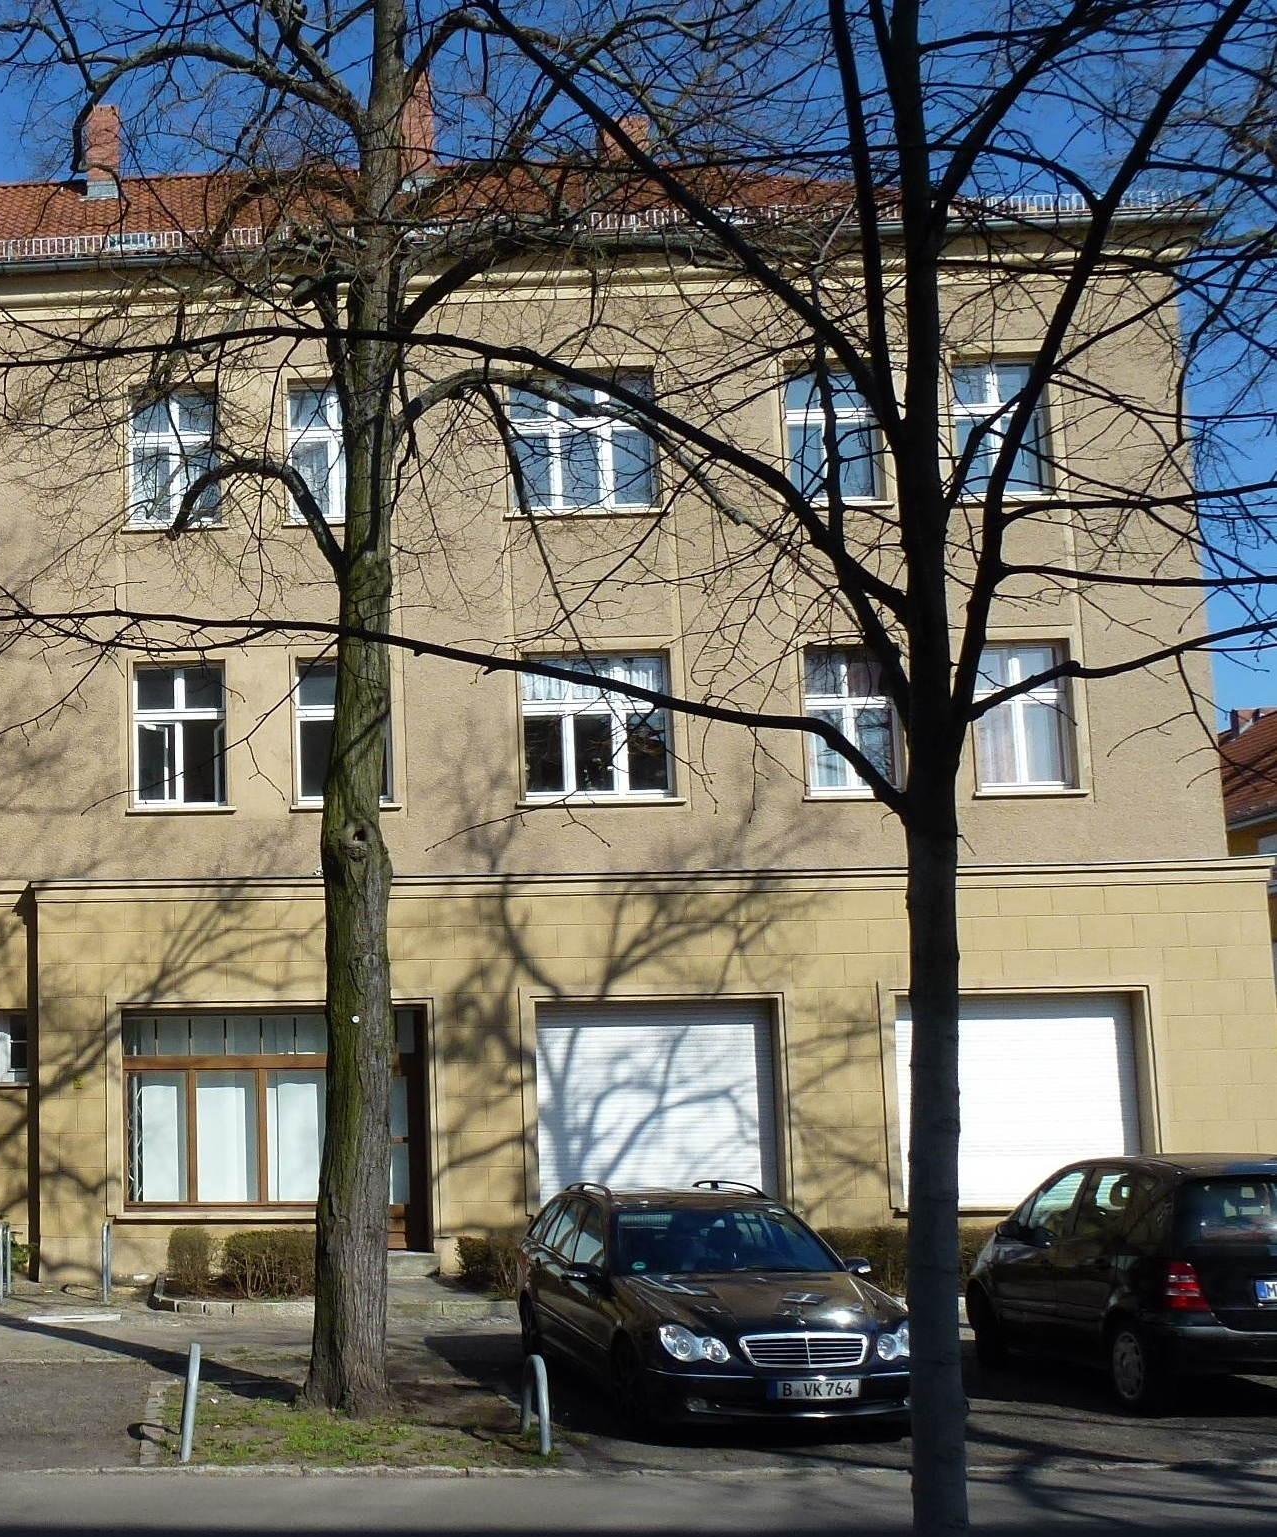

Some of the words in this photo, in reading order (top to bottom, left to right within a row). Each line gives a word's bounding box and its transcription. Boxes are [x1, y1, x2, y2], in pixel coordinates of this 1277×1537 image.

[782, 1382, 793, 1397] B
[803, 1382, 823, 1397] VK
[825, 1381, 853, 1397] 764
